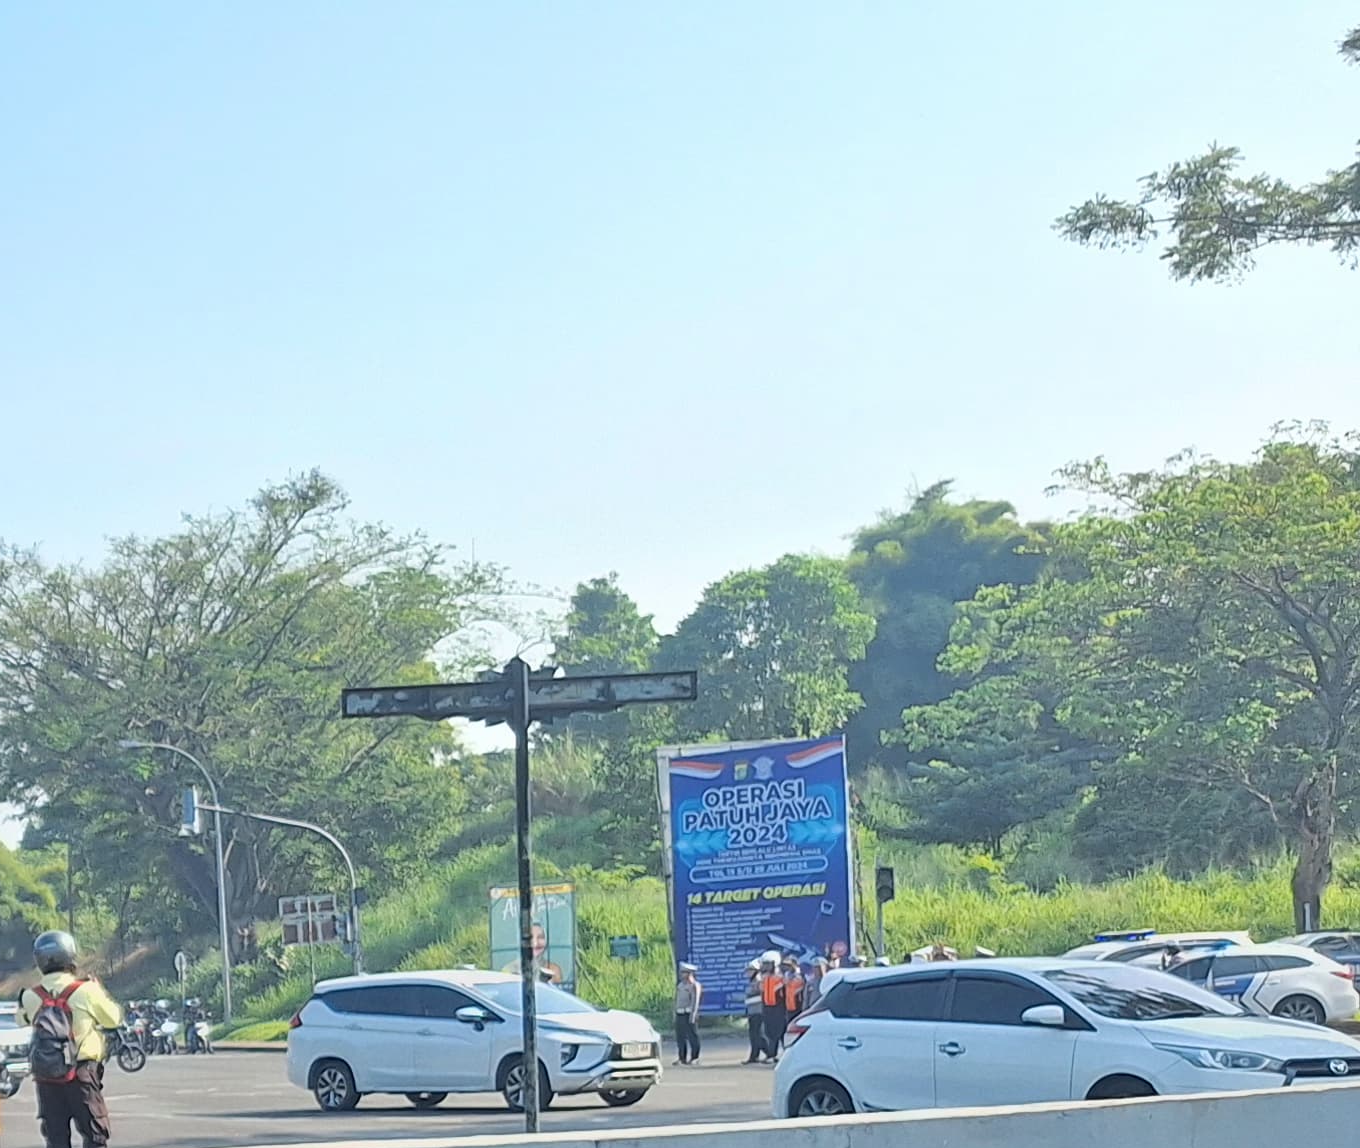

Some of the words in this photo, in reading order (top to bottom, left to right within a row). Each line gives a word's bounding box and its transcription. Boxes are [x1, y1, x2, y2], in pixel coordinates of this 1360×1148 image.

[702, 778, 805, 810] OPERASI
[683, 805, 760, 833] PATUH
[763, 796, 831, 823] JAYA
[728, 823, 788, 848] 2024
[687, 893, 702, 905] 14
[704, 887, 761, 904] TARGET
[763, 882, 826, 899] OPERASI
